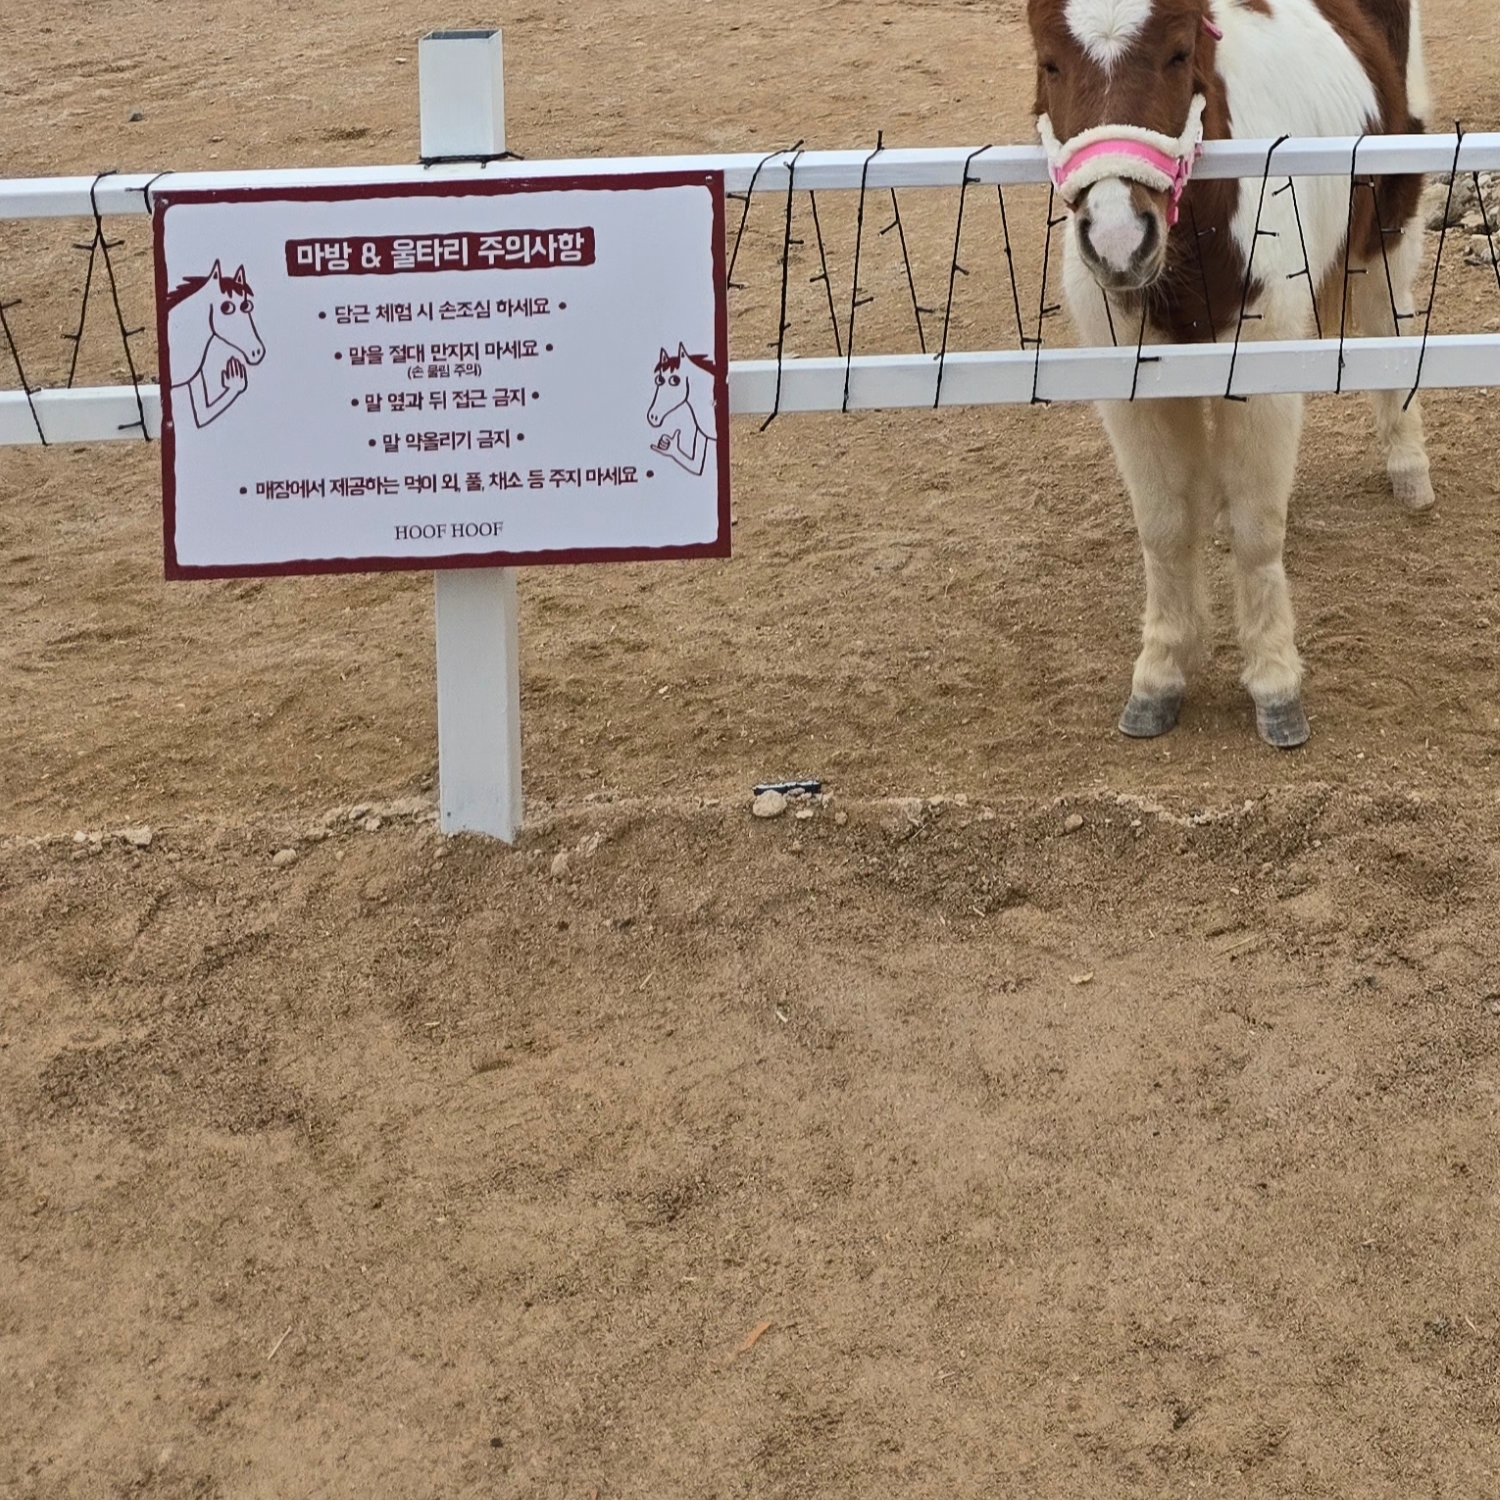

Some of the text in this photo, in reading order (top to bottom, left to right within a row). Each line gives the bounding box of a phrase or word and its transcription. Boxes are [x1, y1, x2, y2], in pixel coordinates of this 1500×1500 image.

[297, 231, 585, 271] 마방 & 울타리 주의사항
[334, 296, 551, 325] 당근 체험 시 손조심 하세요
[349, 338, 540, 366] 말을 절대 만지지 마세요
[407, 365, 424, 380] (손
[453, 363, 483, 378] 주의)
[365, 387, 526, 413] 말 옆과 뒤 접근 금지
[382, 428, 511, 454] 말 약올리기 금지
[255, 465, 639, 500] 매장에서 제공하는 먹이 외, 풀, 채소 등 주지 마세요
[394, 521, 505, 541] HOOF HOOF
